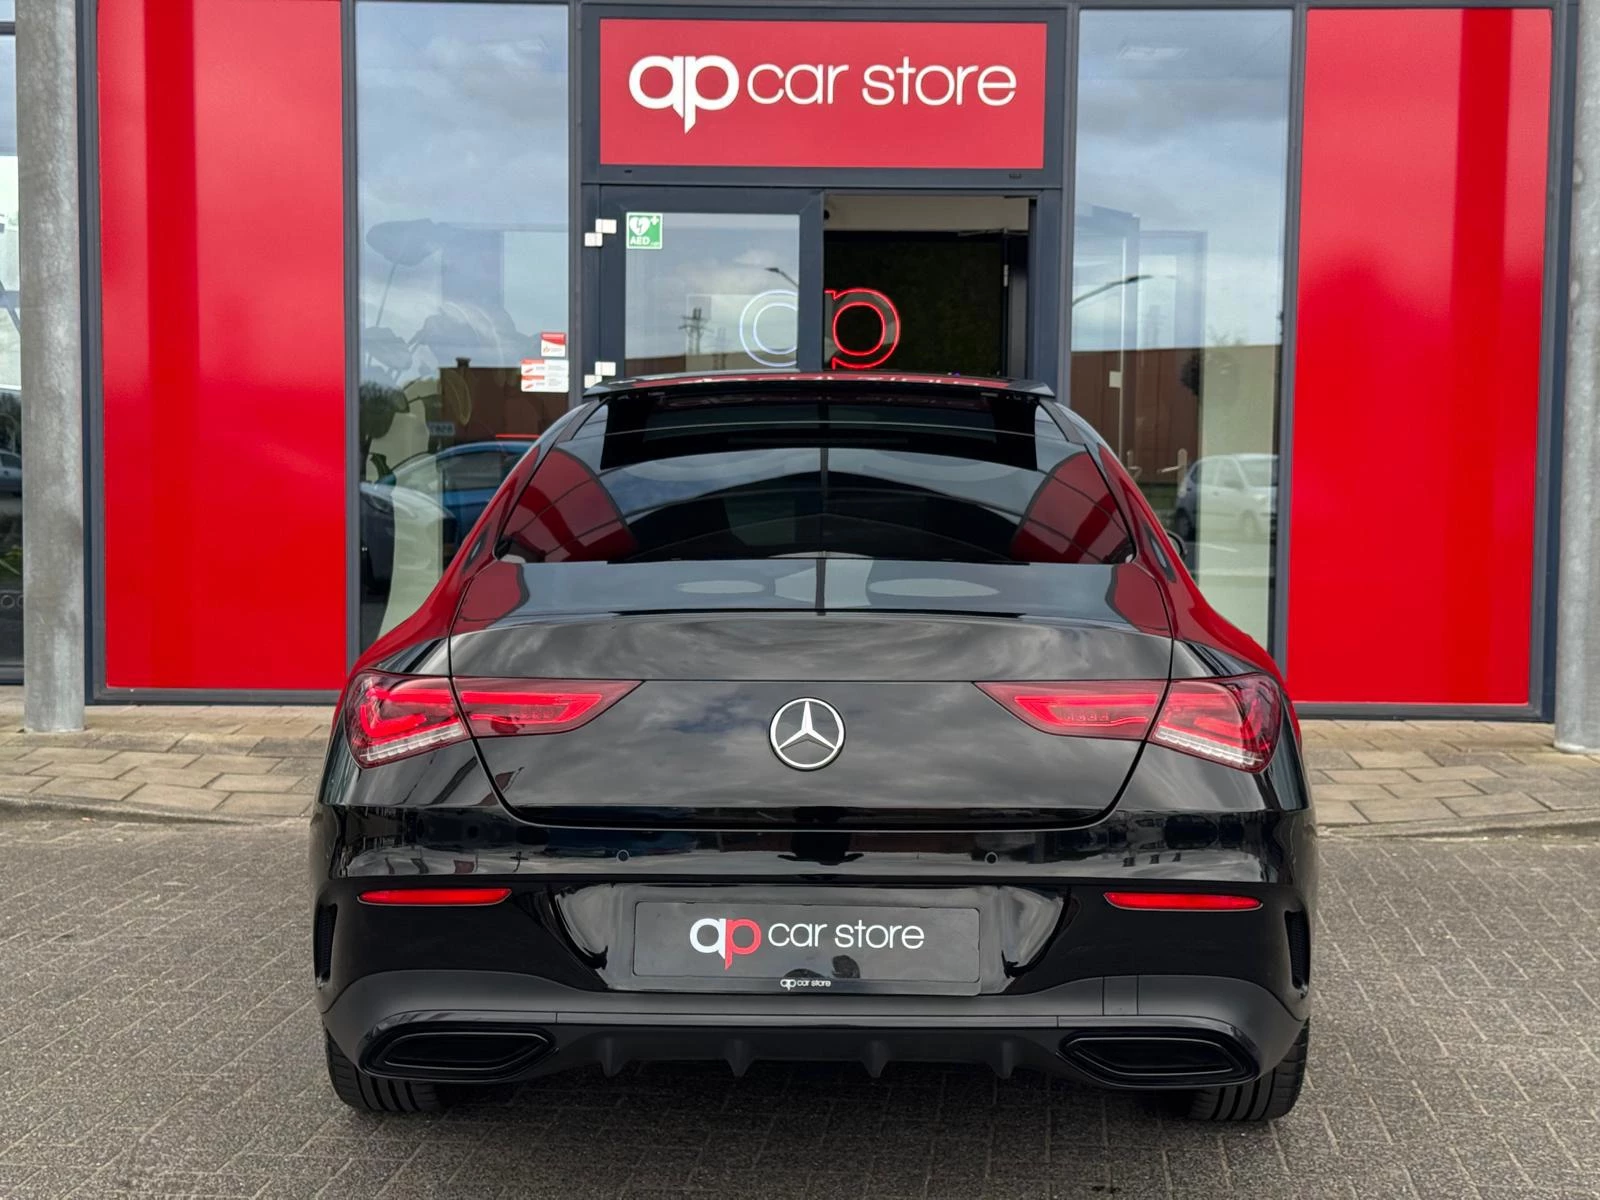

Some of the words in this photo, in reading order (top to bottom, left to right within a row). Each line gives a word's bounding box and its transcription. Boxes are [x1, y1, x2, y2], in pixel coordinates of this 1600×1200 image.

[746, 63, 849, 105] car
[861, 56, 1017, 106] store
[630, 236, 651, 246] AED
[767, 922, 828, 947] car
[834, 919, 925, 949] store
